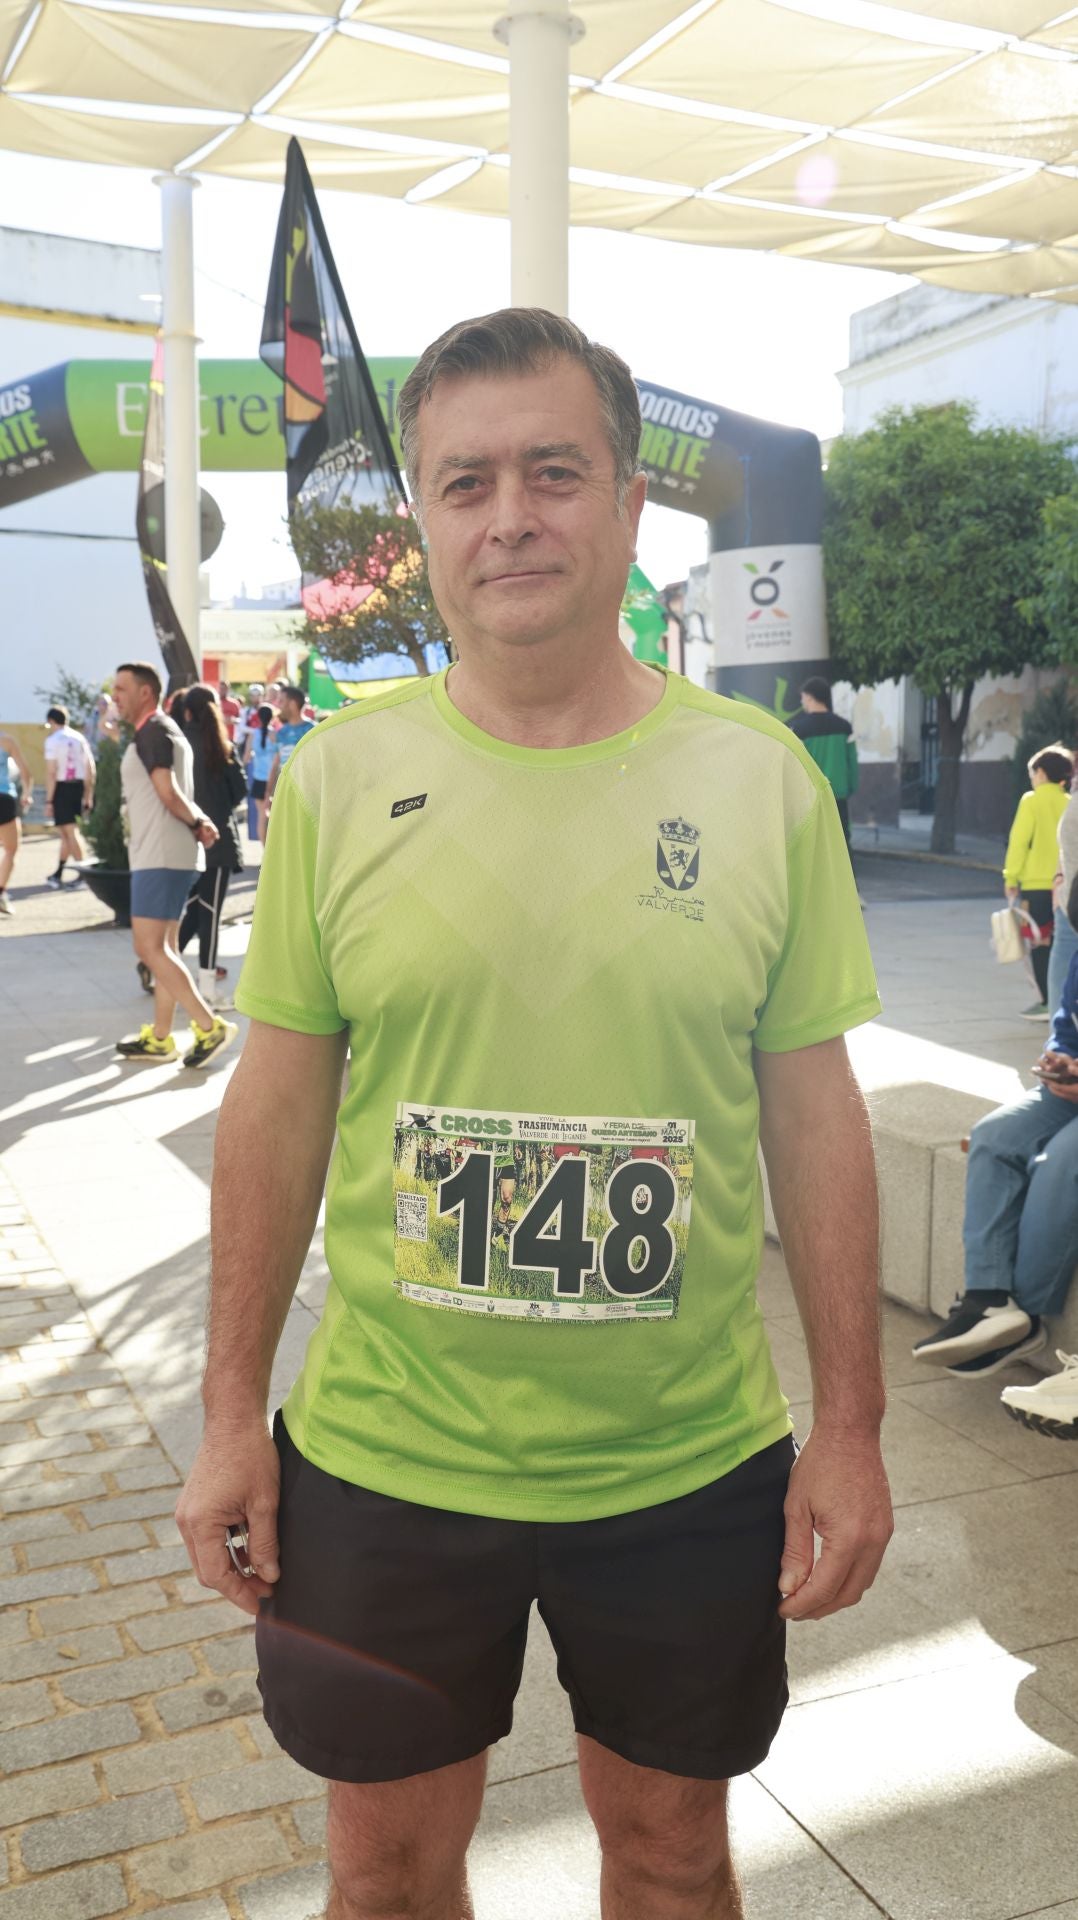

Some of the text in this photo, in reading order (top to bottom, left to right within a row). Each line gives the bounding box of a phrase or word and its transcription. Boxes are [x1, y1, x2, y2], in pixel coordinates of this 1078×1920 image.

[0, 384, 32, 419] OS
[640, 391, 719, 439] OMOS
[0, 410, 48, 461] RTE
[640, 421, 711, 480] ORTE
[637, 899, 705, 918] VALVERDE
[440, 1114, 513, 1136] CROSS
[518, 1120, 588, 1132] TRASHUMANCIA
[519, 1130, 549, 1139] VALVERDE
[609, 1122, 630, 1130] FERIA
[661, 1128, 687, 1137] MAYO
[662, 1136, 684, 1144] 2025
[438, 1152, 677, 1296] 148
